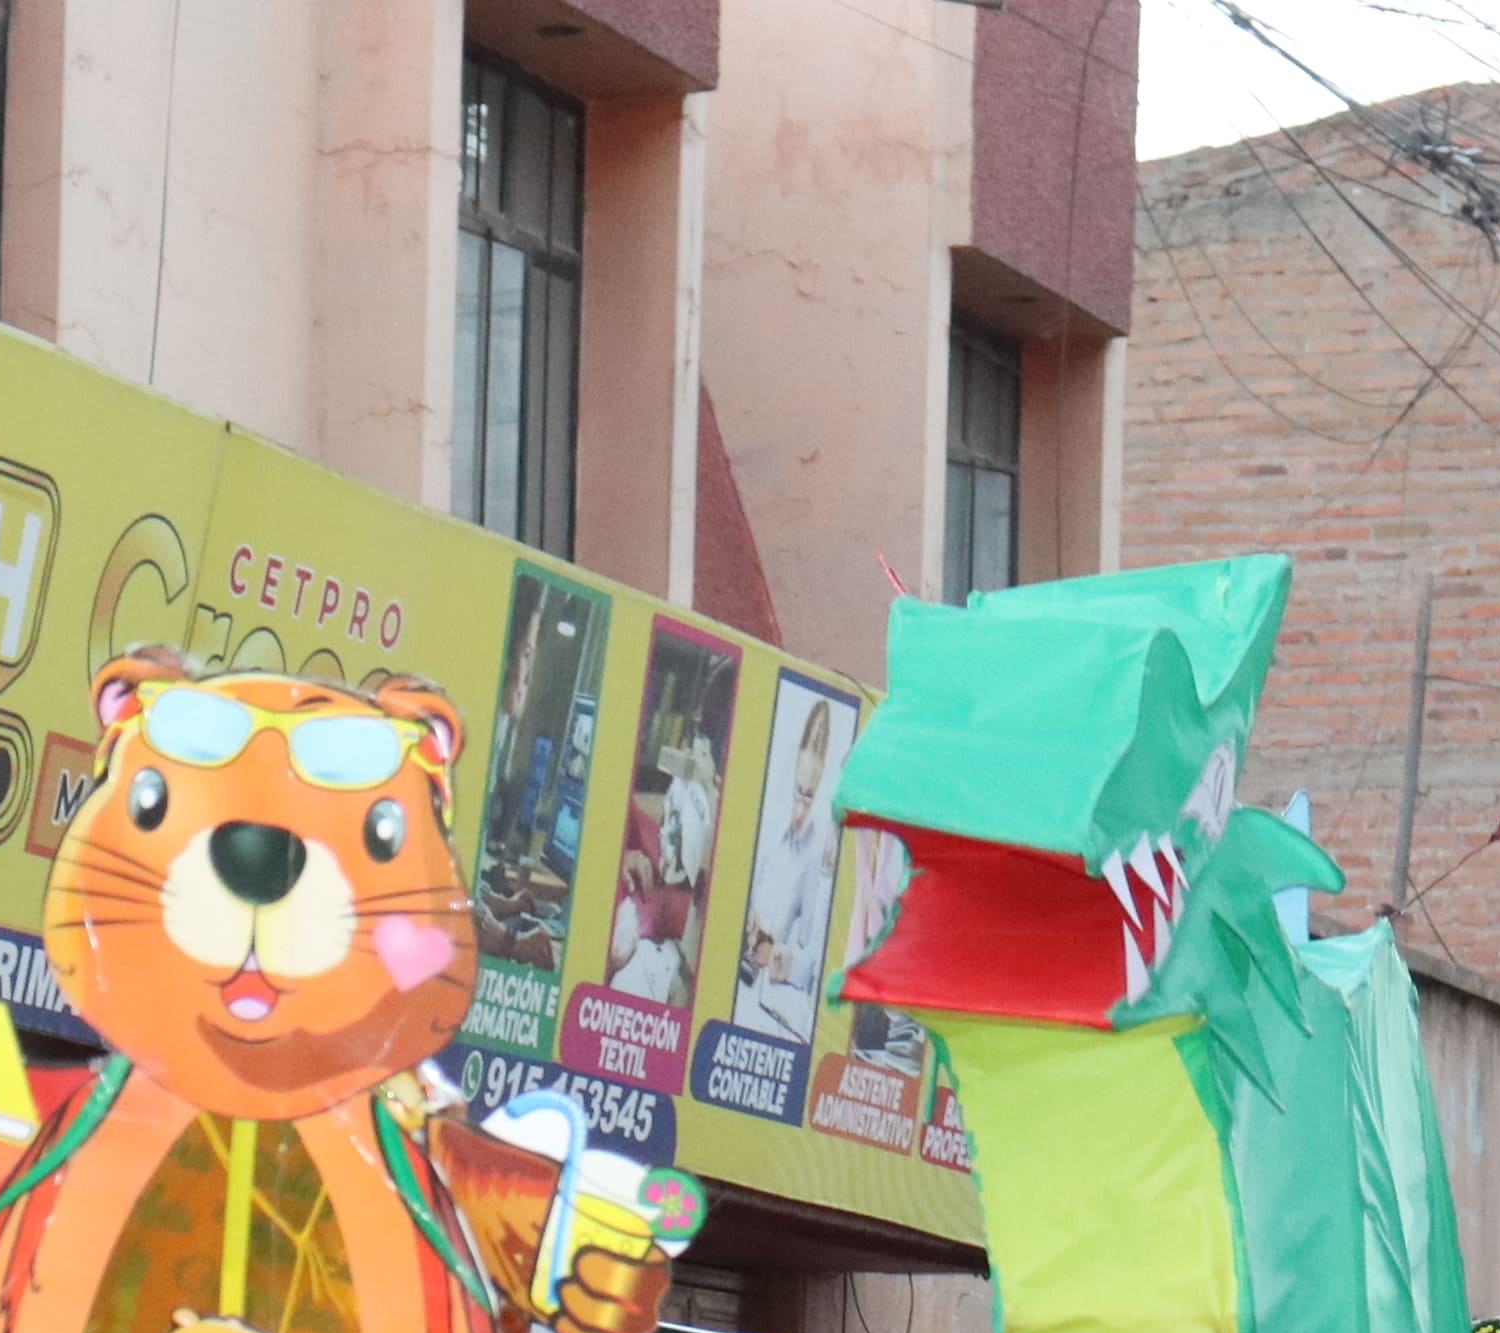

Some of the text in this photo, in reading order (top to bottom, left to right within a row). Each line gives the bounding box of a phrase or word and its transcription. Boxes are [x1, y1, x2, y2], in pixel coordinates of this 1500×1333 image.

[229, 545, 404, 650] CETPRO
[578, 996, 682, 1053] CONFECCIÓN
[597, 1037, 647, 1080] TEXTIL
[712, 1032, 796, 1082] ASISTENTE
[708, 1069, 787, 1115] CONTABLE
[838, 1063, 904, 1112] ASISTENTE
[812, 1094, 914, 1150] ADMINISTRATIVO
